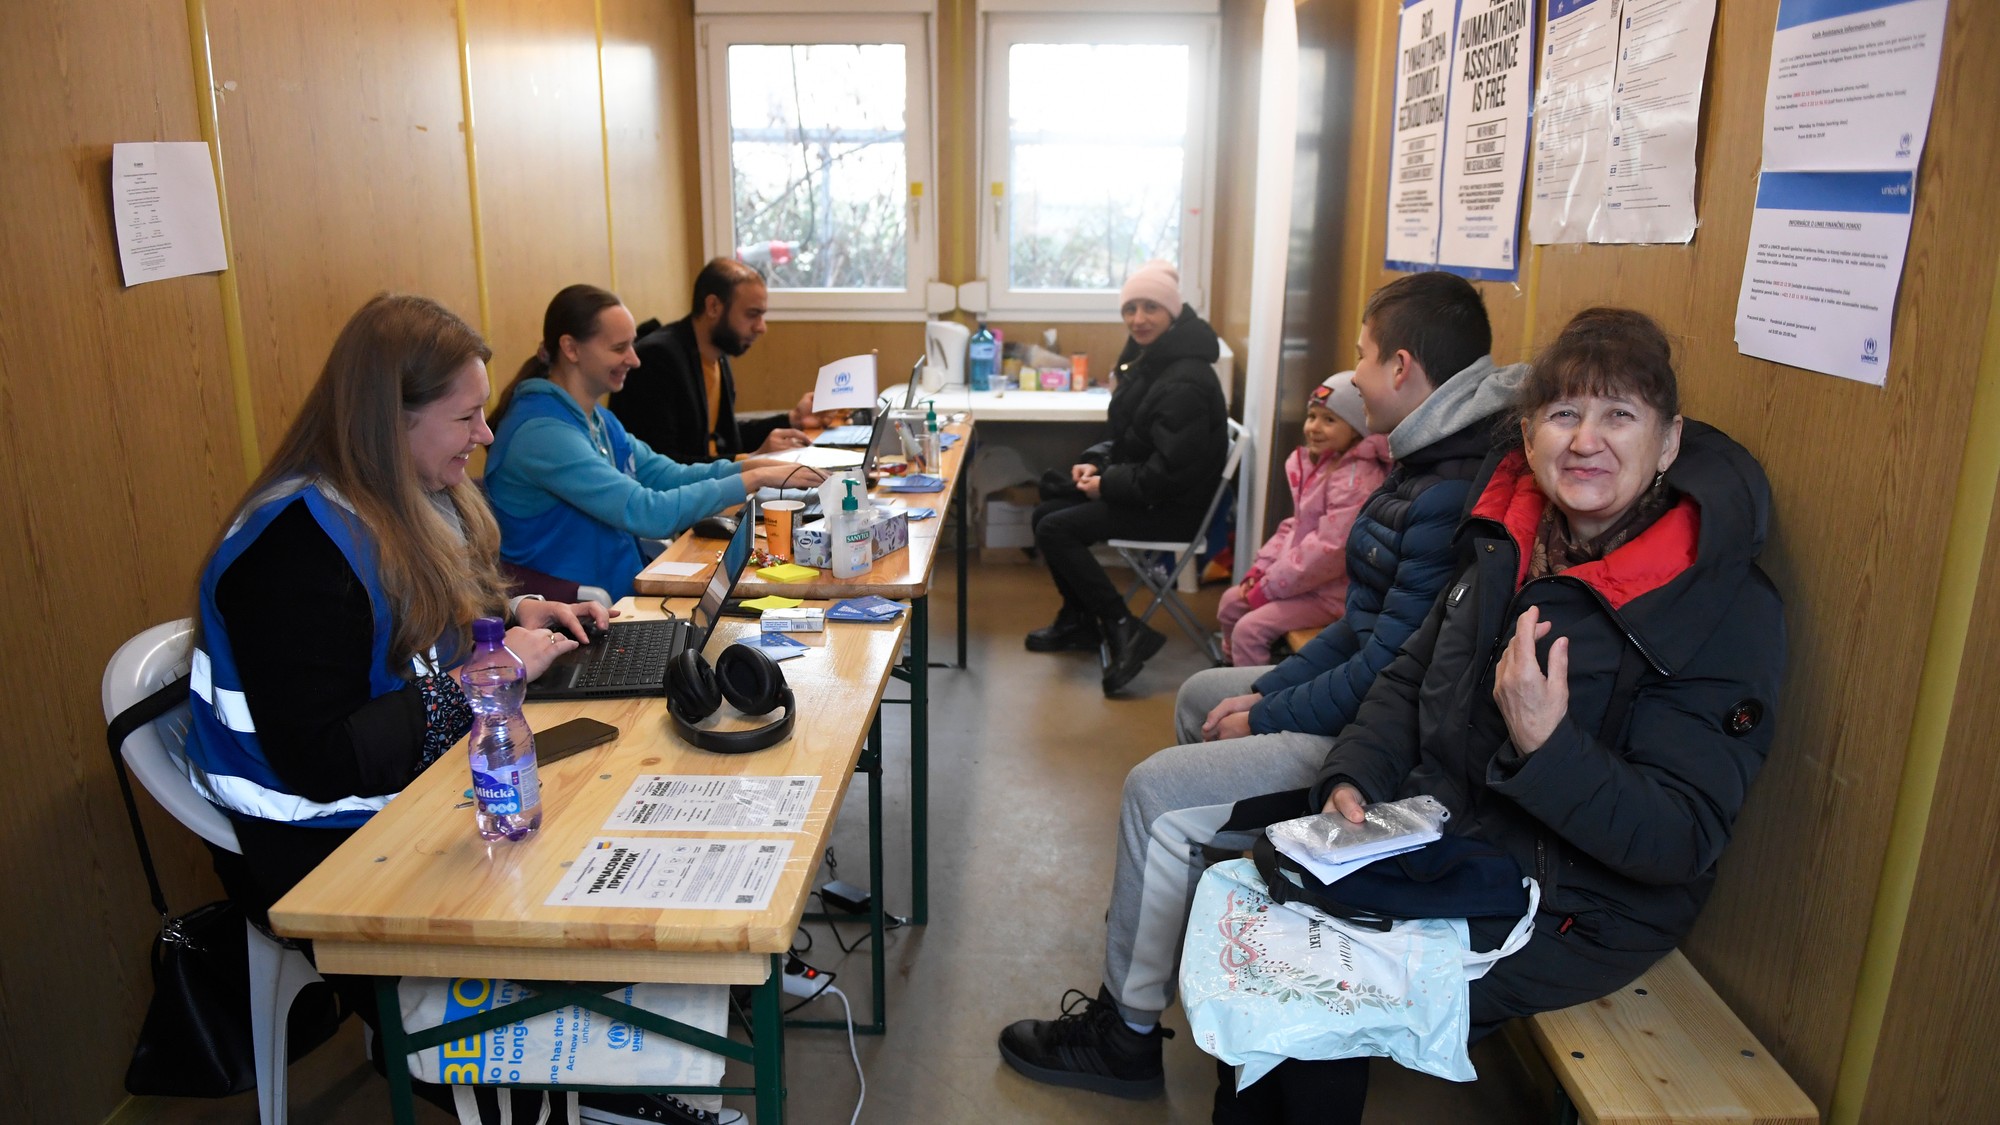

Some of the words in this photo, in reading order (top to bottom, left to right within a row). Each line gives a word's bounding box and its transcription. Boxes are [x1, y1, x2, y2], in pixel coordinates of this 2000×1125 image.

[1460, 0, 1526, 51] HUMANITARIAN
[1463, 33, 1520, 82] ASSISTANCE
[1472, 81, 1484, 113] IS
[1484, 73, 1507, 111] FREE
[1882, 185, 1900, 195] unicef
[1860, 354, 1878, 362] UNHCR
[846, 532, 869, 543] SANYTOL
[587, 848, 628, 894] ТИМЧАСОВИЙ
[606, 851, 640, 889] ПРИТУЛОК
[1310, 933, 1321, 948] TEXT
[1338, 935, 1354, 971] rame
[444, 977, 490, 1084] BEO
[490, 1024, 508, 1062] long
[508, 1018, 528, 1064] longe
[554, 1017, 564, 1037] the
[572, 1022, 579, 1032] to
[582, 1007, 591, 1044] unhcr.o
[550, 1040, 562, 1062] has
[570, 1034, 578, 1054] now
[566, 1055, 576, 1071] Act
